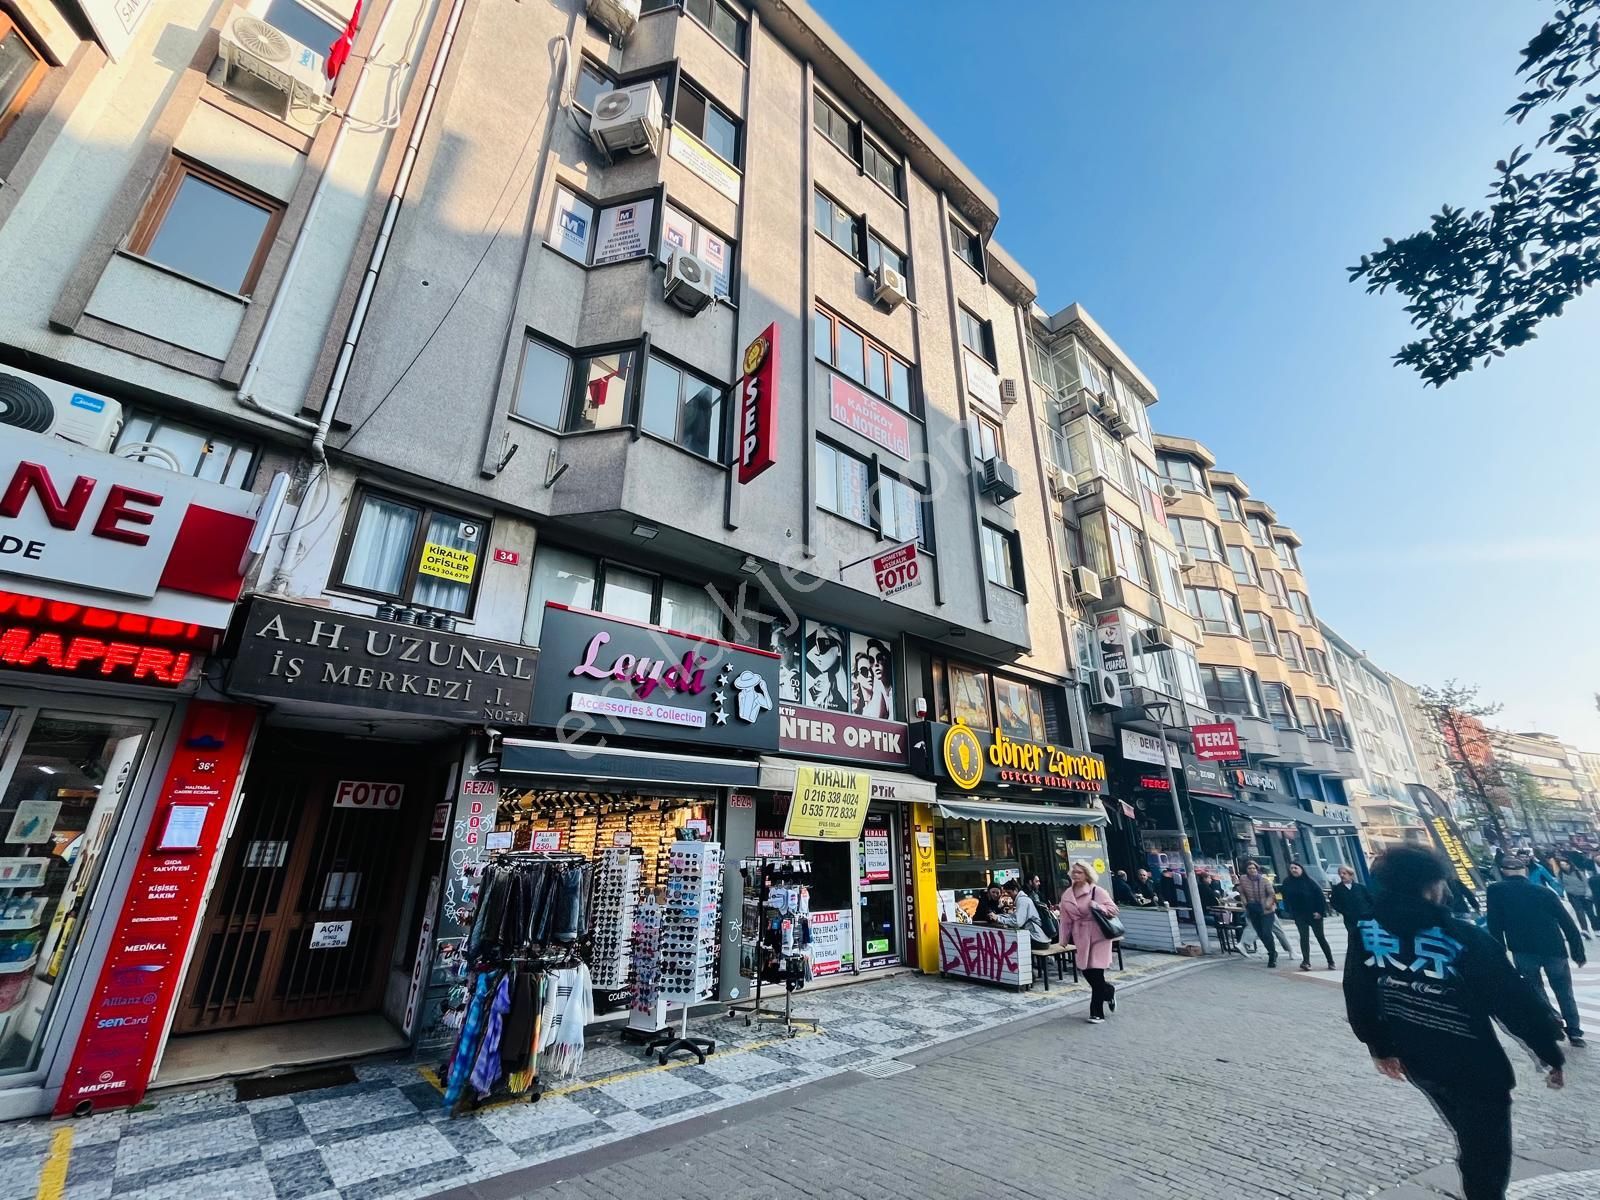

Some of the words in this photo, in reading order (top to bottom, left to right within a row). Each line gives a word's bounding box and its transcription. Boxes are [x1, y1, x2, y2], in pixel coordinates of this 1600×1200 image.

[743, 377, 757, 466] SEP
[835, 402, 849, 426] 10.
[427, 556, 469, 572] OFİSLER
[430, 546, 469, 563] KİRALIK
[500, 551, 513, 562] 34
[876, 561, 918, 592] FOTO
[256, 614, 350, 651] A.H.
[366, 630, 530, 680] UZUNAL
[572, 631, 707, 699] Leydi
[269, 650, 304, 683] İŞ
[322, 662, 472, 702] MERKEZİ
[577, 696, 643, 716] Accessories
[646, 708, 653, 717] &
[656, 708, 703, 724] Collection
[779, 715, 836, 745] NTER
[843, 726, 902, 754] OPTİK
[1196, 729, 1234, 747] TERZİ
[989, 728, 1043, 771] döner
[1048, 746, 1105, 780] zamanı
[463, 781, 494, 794] FEZA
[813, 768, 857, 790] KİRALIK
[1001, 771, 1042, 785] GERÇEK
[1045, 776, 1072, 788] HATAY
[1075, 782, 1101, 792] SOSLU
[336, 782, 400, 806] FOTO
[730, 795, 752, 808] FEZA
[804, 788, 809, 801] 0
[811, 789, 826, 803] 216
[827, 792, 841, 804] 338
[842, 795, 859, 806] 4024
[801, 803, 806, 816] 0
[808, 805, 824, 817] 535
[825, 806, 838, 818] 772
[839, 807, 857, 820] 8334
[148, 884, 179, 892] KİŞİSEL
[906, 895, 916, 939] OPTİK
[320, 924, 344, 933] AÇIK
[125, 943, 166, 952] MEDİKAL
[1357, 918, 1464, 979] 東京
[103, 997, 141, 1005] Allianz
[98, 1015, 148, 1028] senCard
[78, 1080, 126, 1093] MAPFRE
